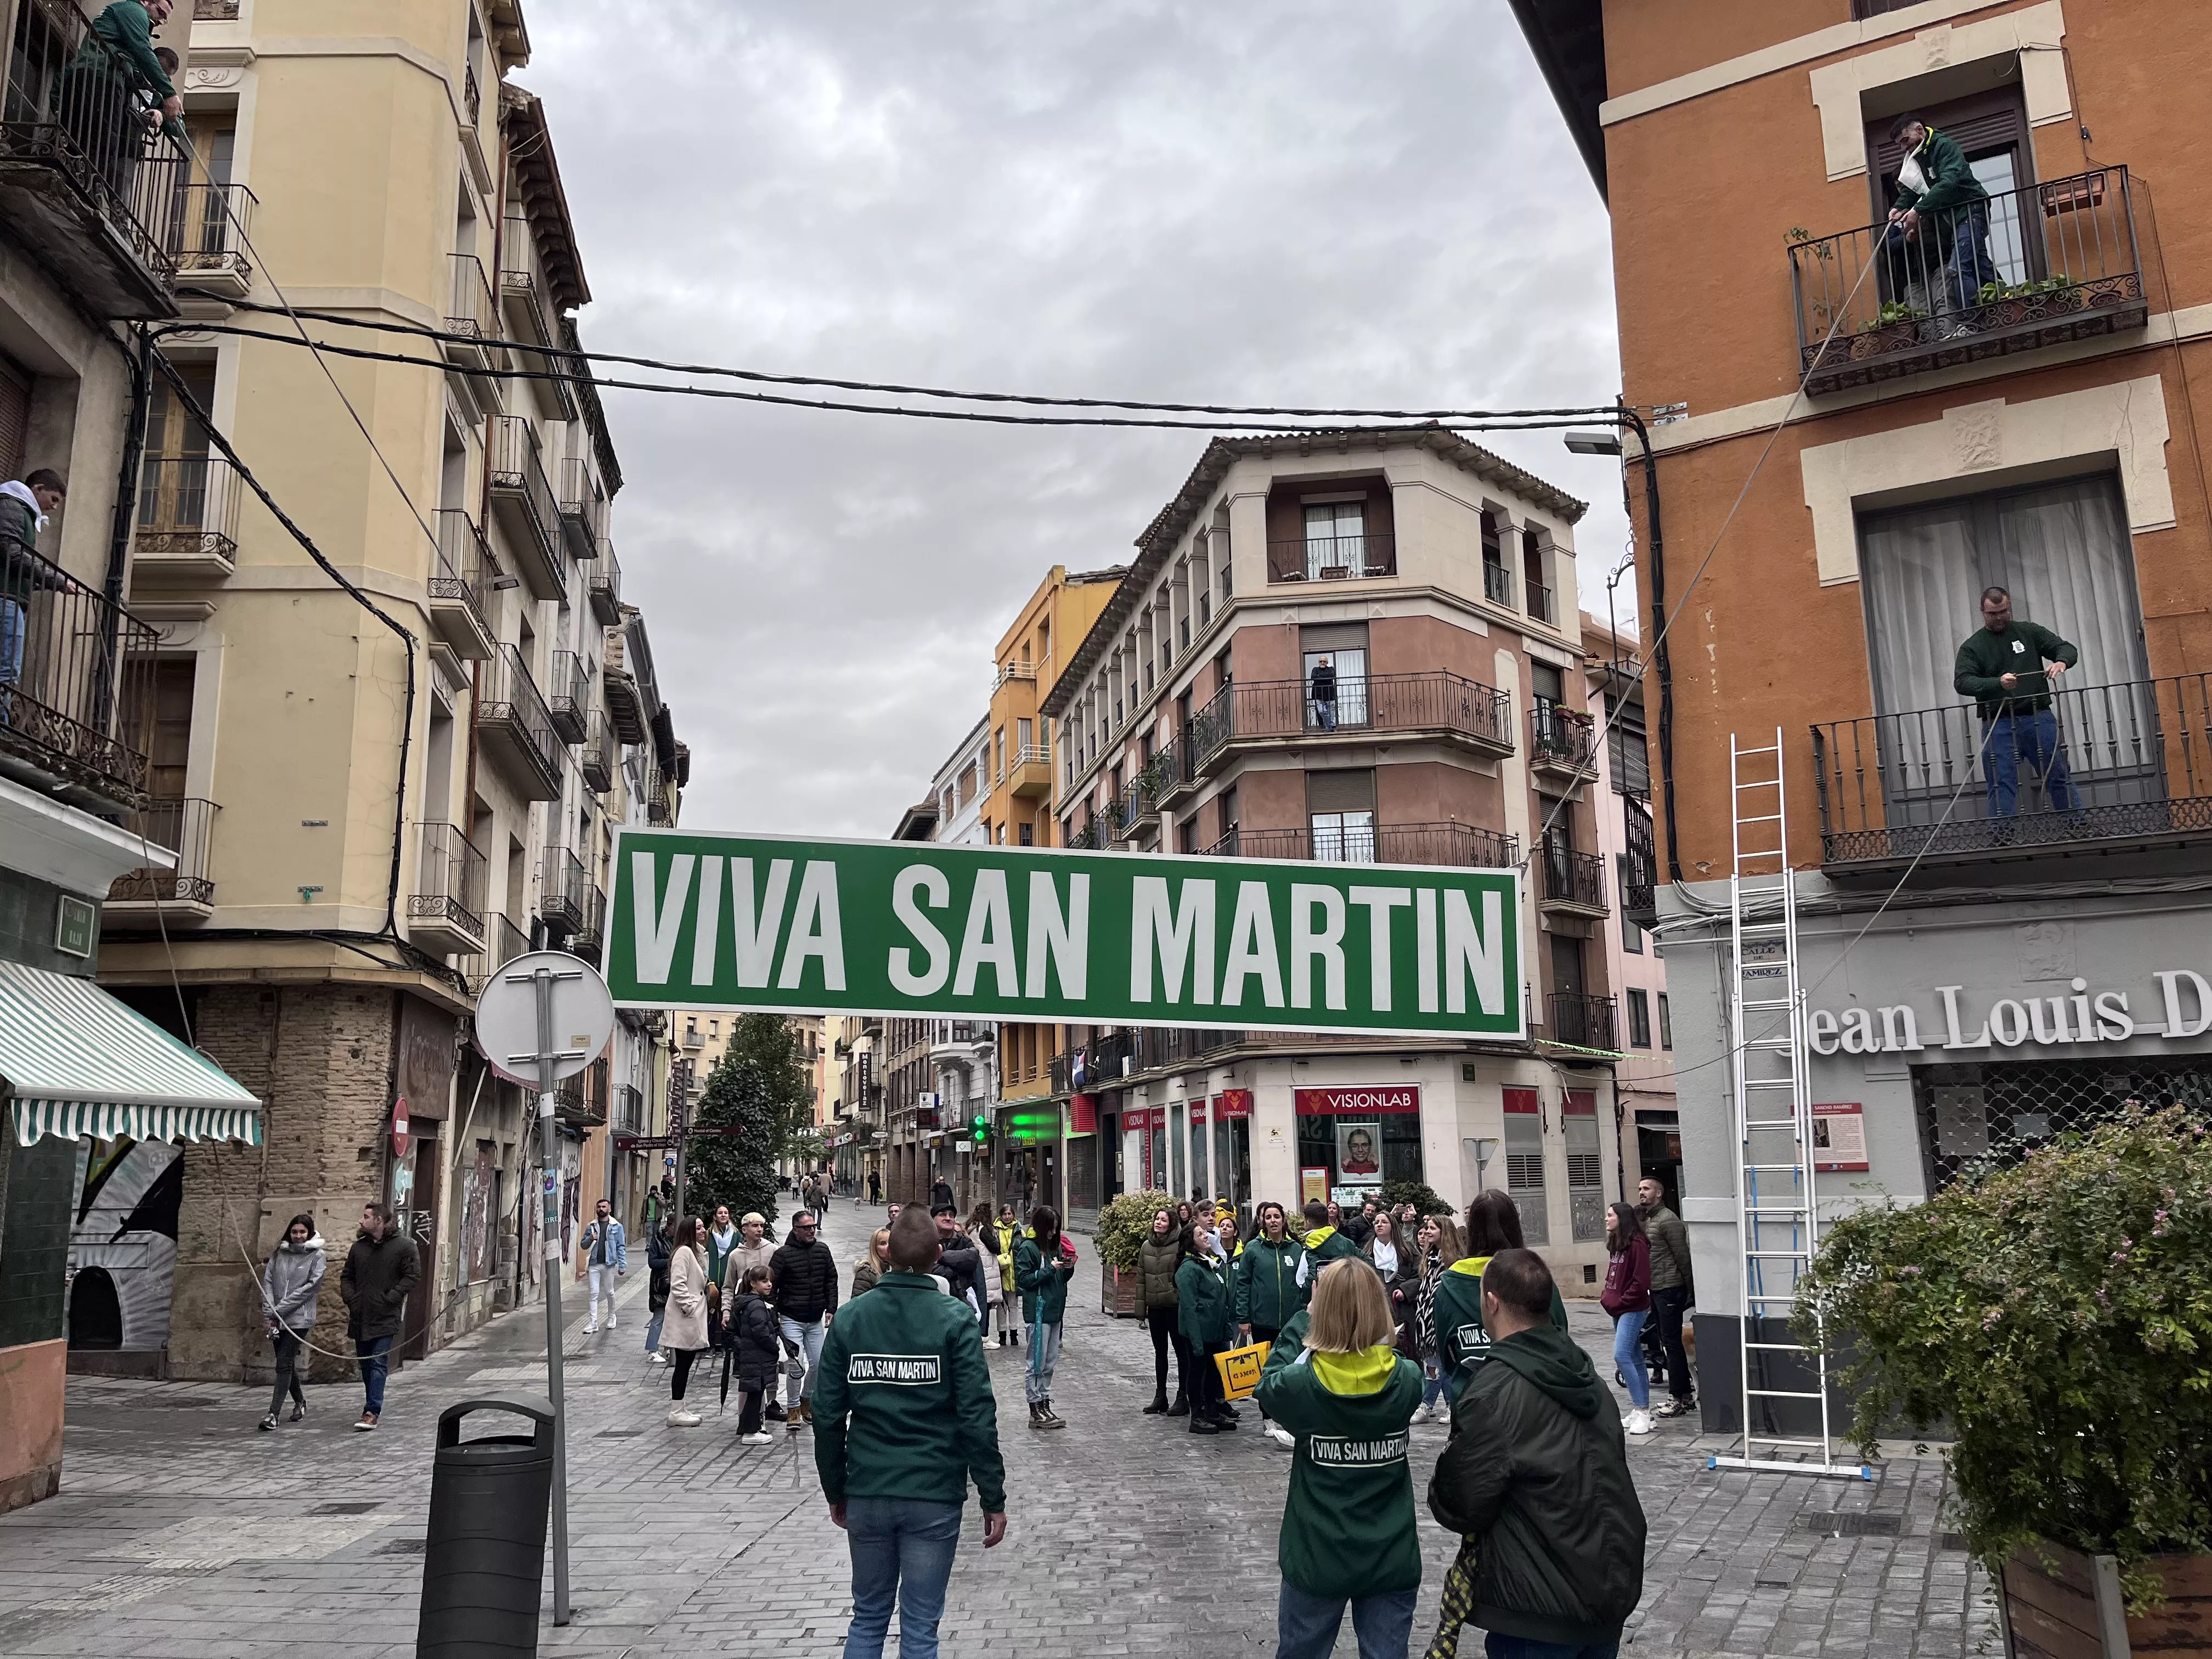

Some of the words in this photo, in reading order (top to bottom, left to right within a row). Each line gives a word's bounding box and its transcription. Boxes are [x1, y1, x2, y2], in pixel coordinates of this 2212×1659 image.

[631, 851, 847, 991] VIVA
[888, 863, 1090, 1001] SAN
[1129, 876, 1505, 1015] MARTIN
[1741, 947, 1775, 956] CALLE
[1934, 977, 2135, 1049] Louis
[1327, 1092, 1412, 1109] VISIONLAB
[1460, 1329, 1481, 1344] VIVA
[852, 1360, 874, 1378] VIVA
[876, 1361, 896, 1379] SAN
[898, 1361, 936, 1379] MARTIN
[1316, 1442, 1342, 1460] VIVA
[1344, 1442, 1367, 1460] SAN
